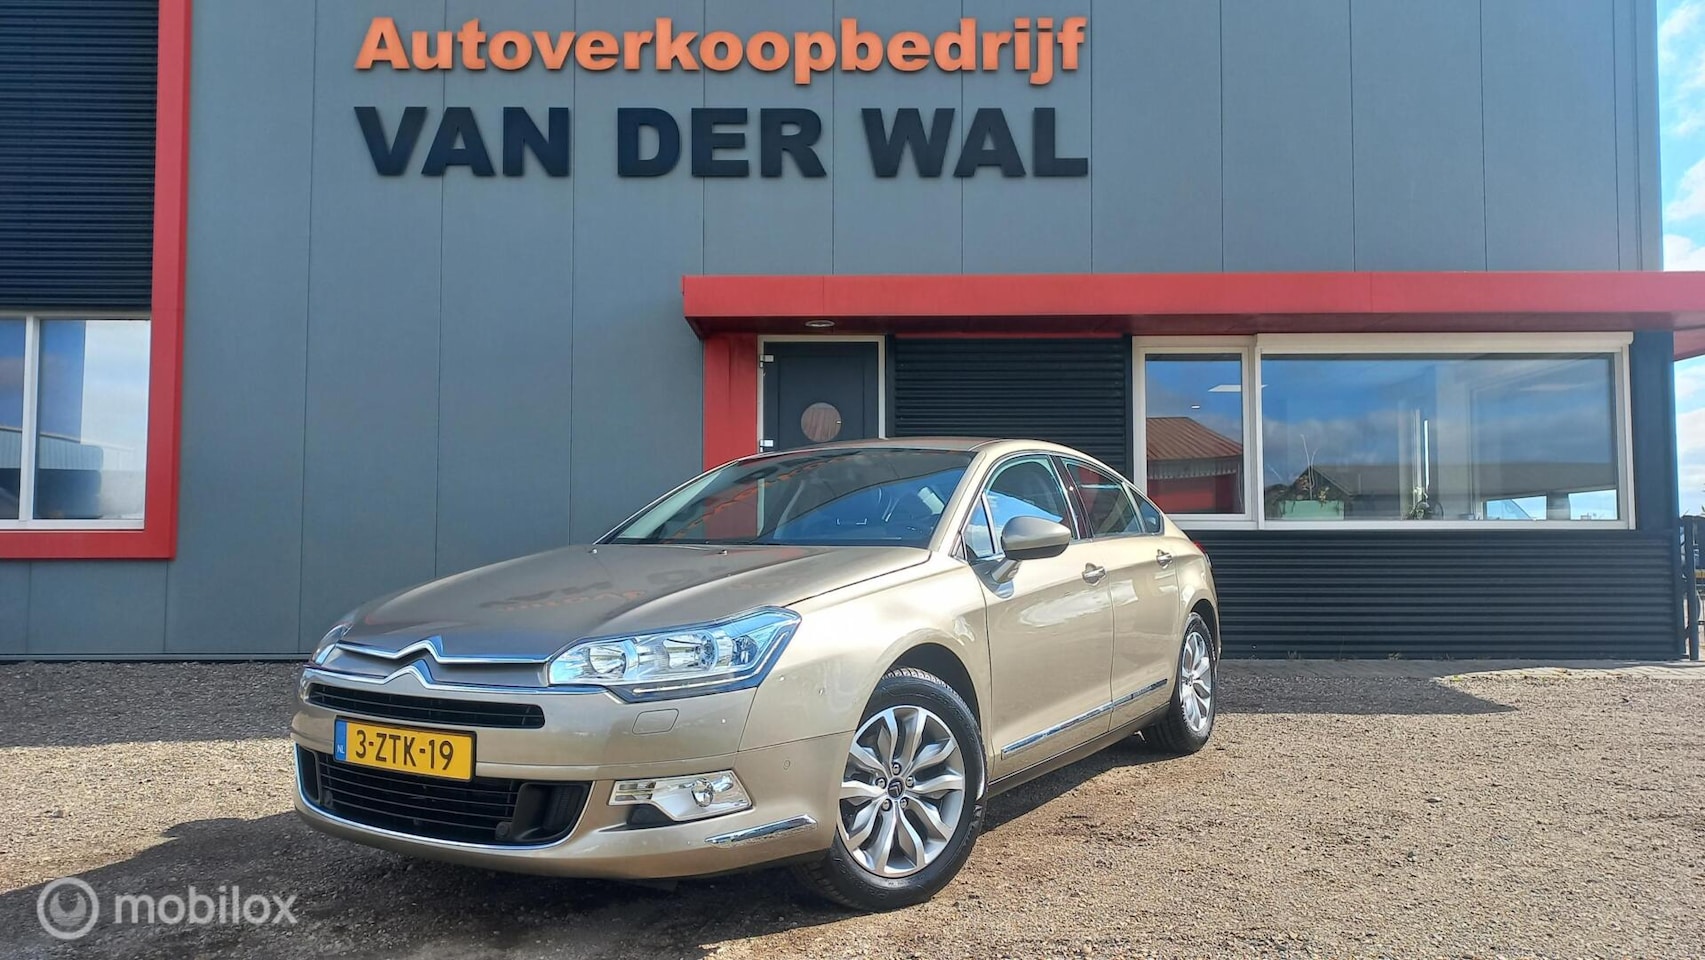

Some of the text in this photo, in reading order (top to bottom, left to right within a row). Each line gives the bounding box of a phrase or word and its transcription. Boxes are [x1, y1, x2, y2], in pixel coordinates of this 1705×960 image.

[354, 17, 1088, 85] Autoverkoopbedrijf
[354, 106, 1089, 178] VAN DER WAL
[336, 744, 345, 754] NL
[355, 729, 454, 770] 3-ZTK-19
